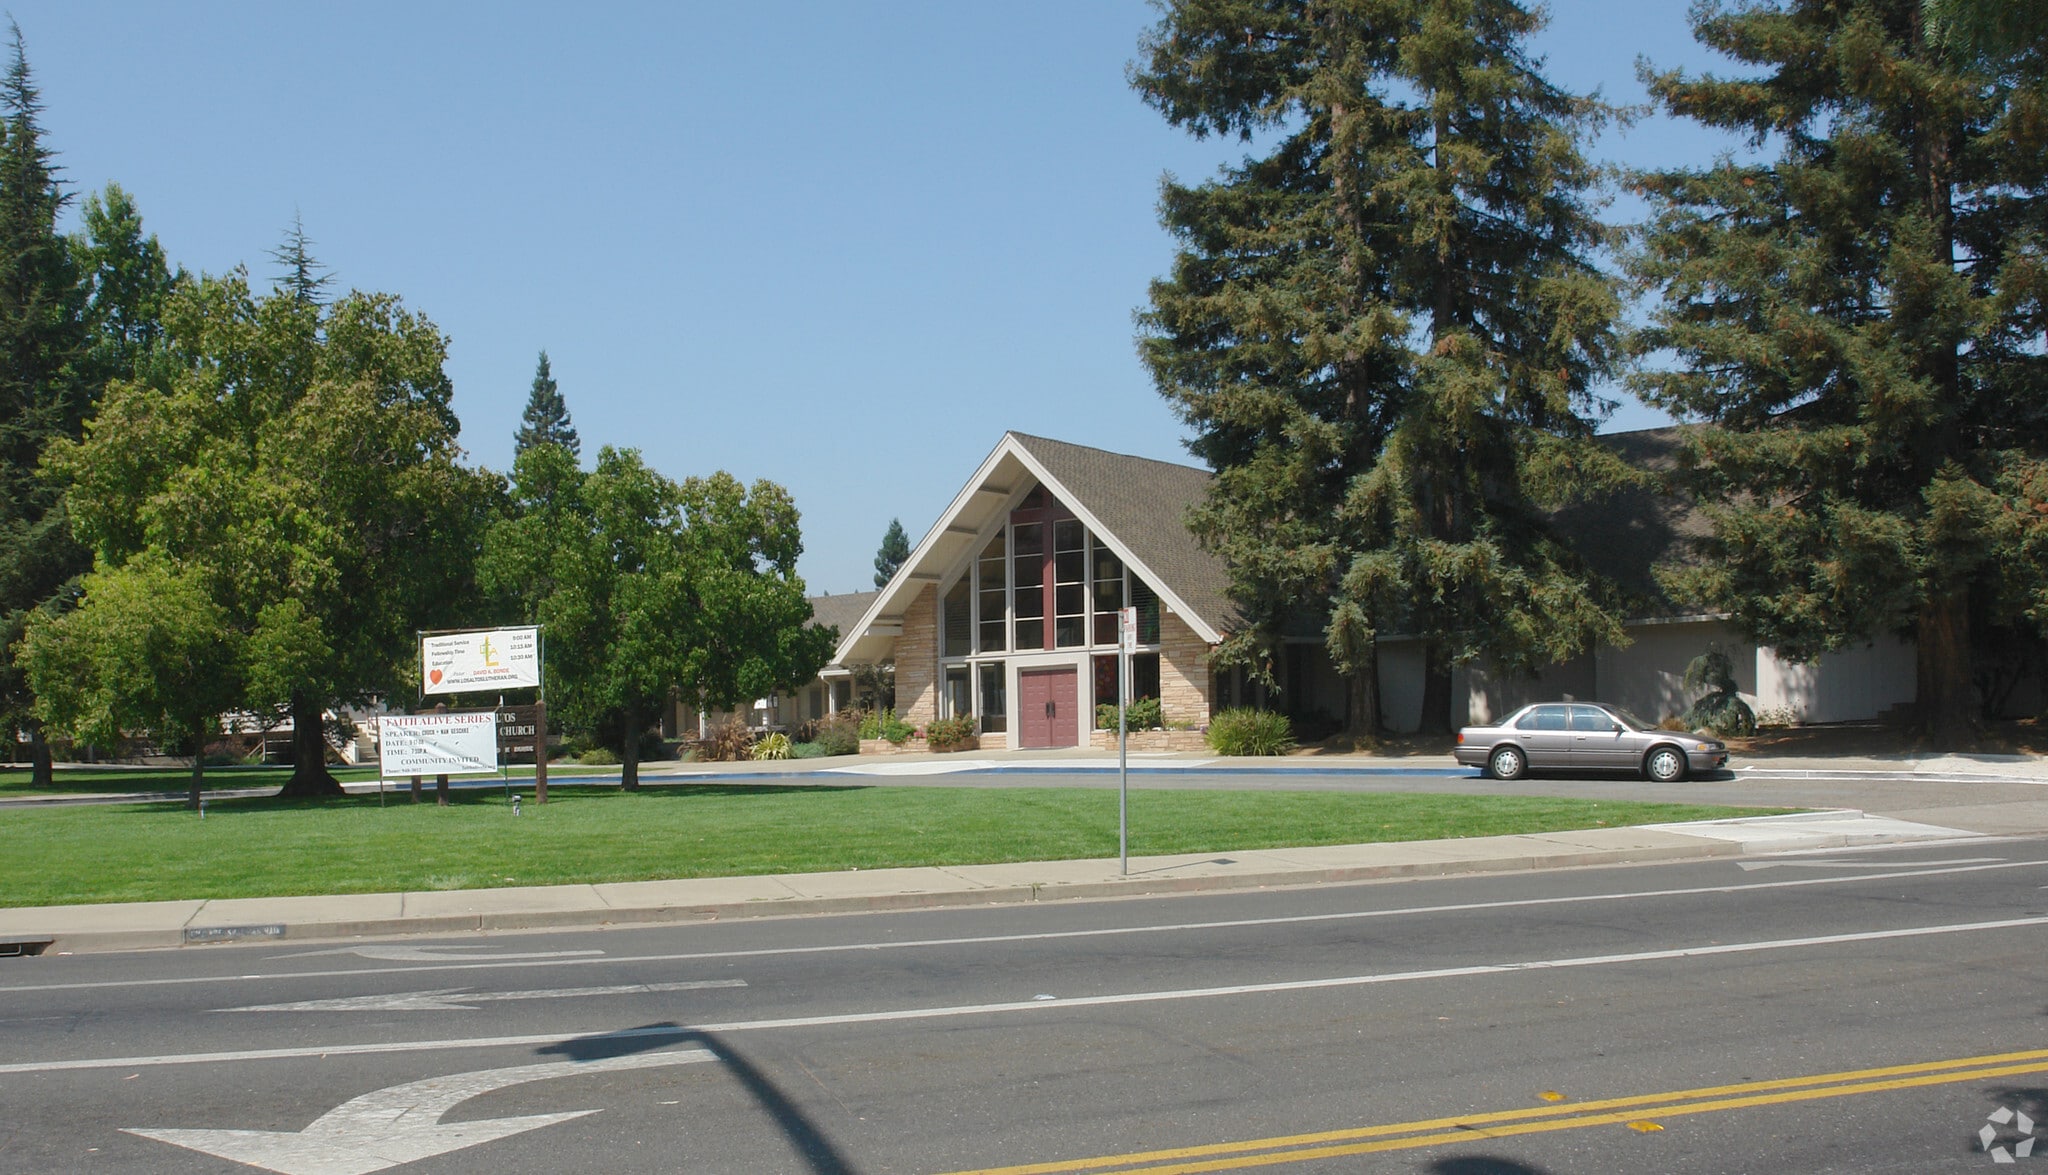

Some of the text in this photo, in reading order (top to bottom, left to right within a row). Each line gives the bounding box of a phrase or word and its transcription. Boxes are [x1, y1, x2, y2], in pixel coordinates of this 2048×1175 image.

[386, 714, 492, 727] FAITH ALIVE SERIES
[385, 730, 420, 738] SPEAKER:
[499, 725, 536, 736] CHURCH
[400, 757, 447, 766] COMMUNITY
